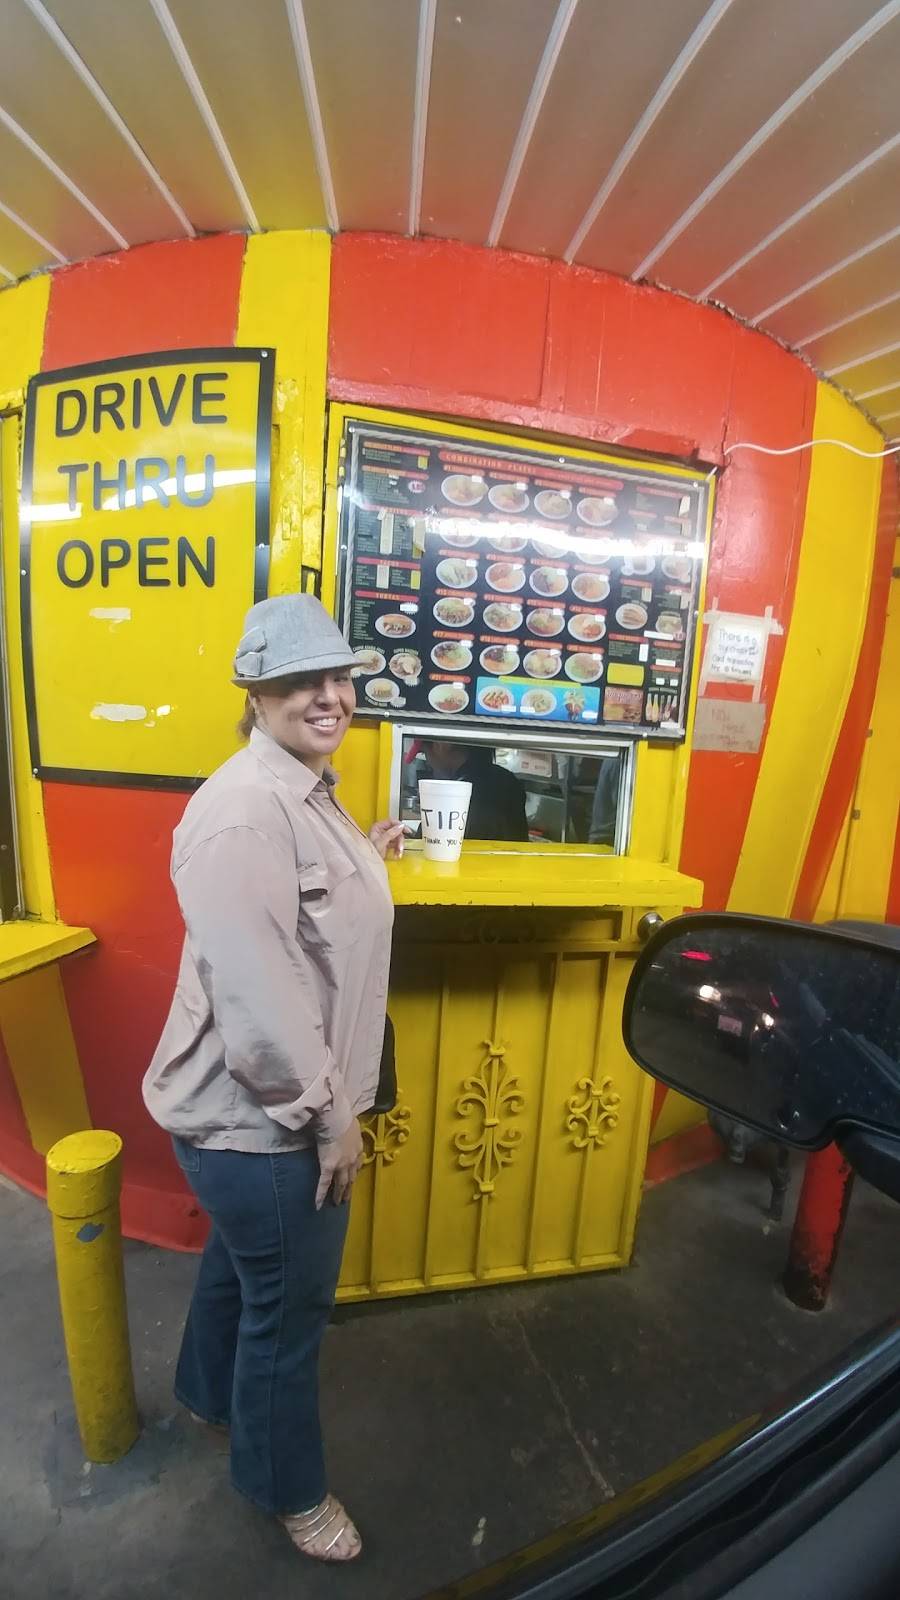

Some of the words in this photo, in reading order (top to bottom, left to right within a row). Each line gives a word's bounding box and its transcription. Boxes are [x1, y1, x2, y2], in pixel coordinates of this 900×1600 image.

[55, 373, 229, 437] DRIVE
[57, 453, 215, 512] THRU
[57, 535, 216, 588] OPEN
[421, 808, 468, 831] TIPS
